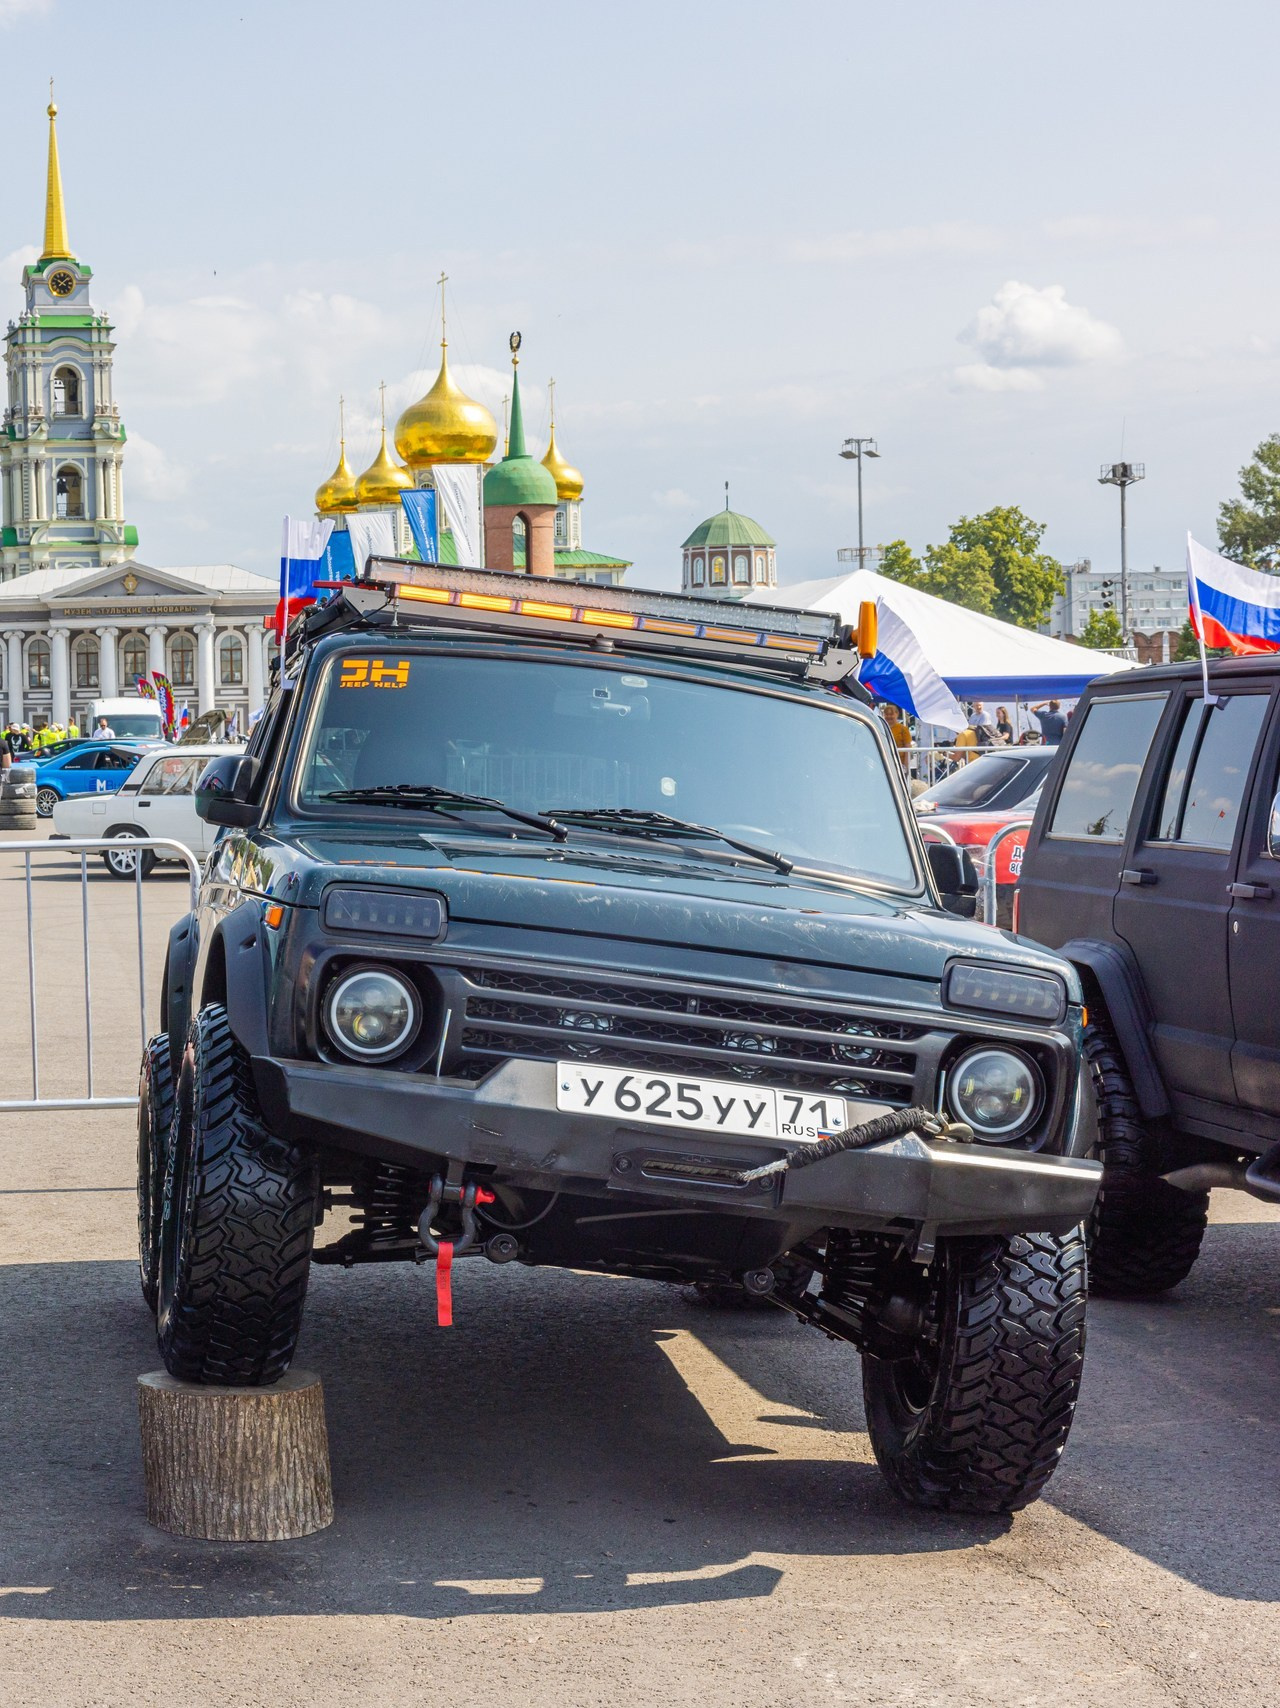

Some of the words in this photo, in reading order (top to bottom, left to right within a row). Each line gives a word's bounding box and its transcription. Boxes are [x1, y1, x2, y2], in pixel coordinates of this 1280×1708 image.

[374, 681, 407, 689] HELP
[782, 1094, 829, 1129] 71
[781, 1122, 816, 1138] RUS
